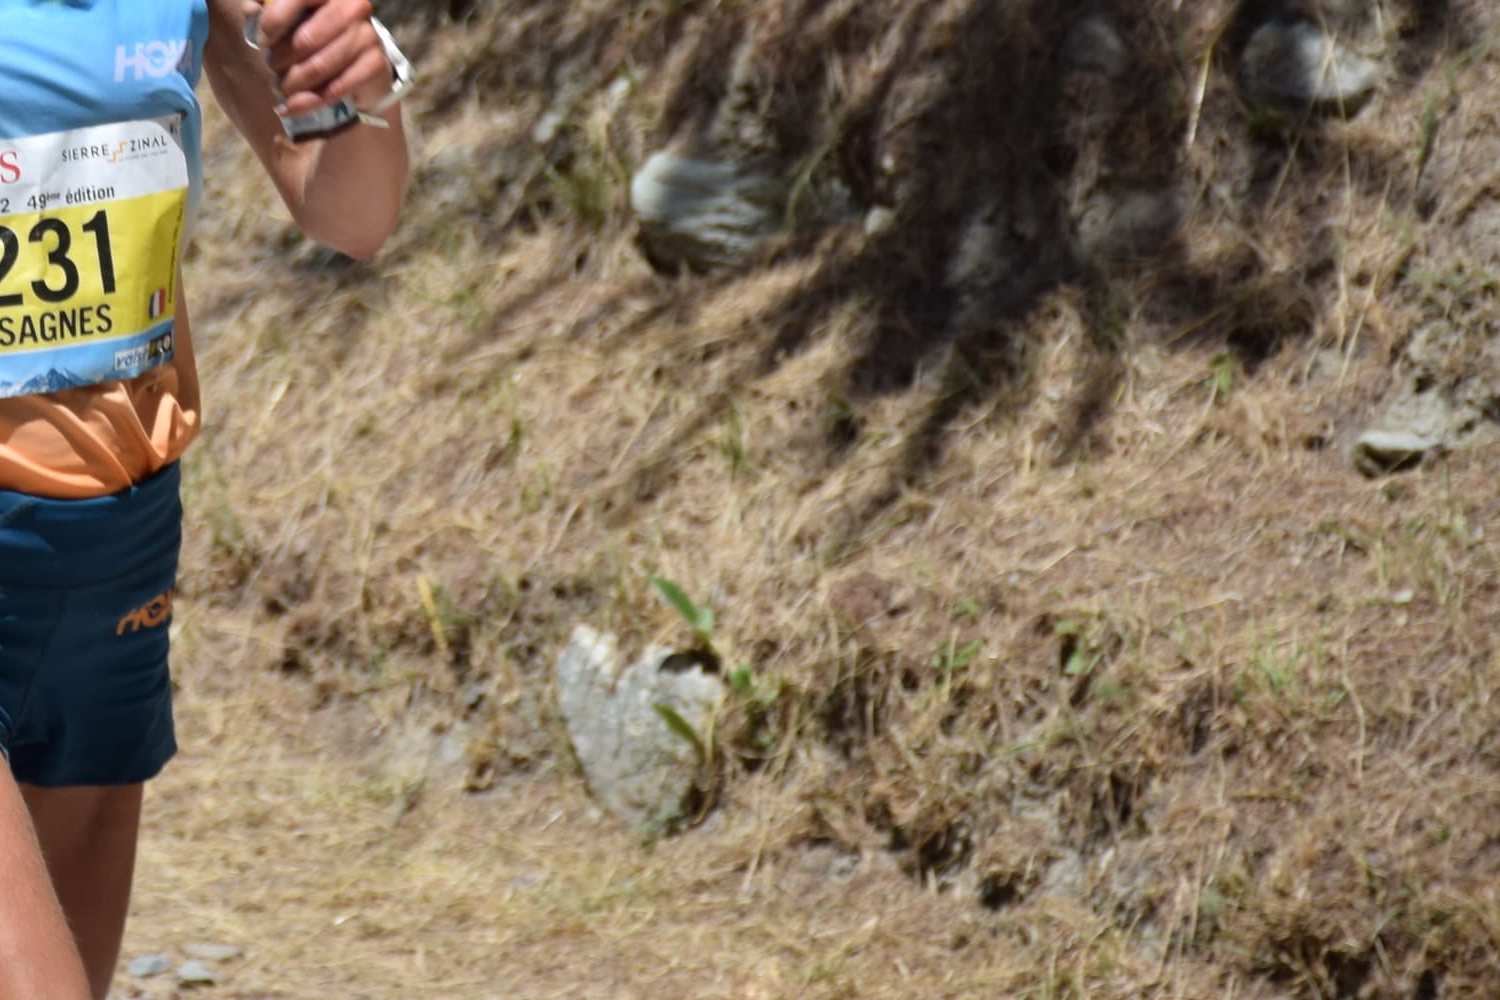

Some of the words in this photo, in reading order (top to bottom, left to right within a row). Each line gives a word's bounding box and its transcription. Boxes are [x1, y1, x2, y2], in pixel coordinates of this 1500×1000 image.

[62, 143, 109, 162] SIERRE
[130, 135, 167, 152] ZINAL
[65, 185, 115, 205] édition
